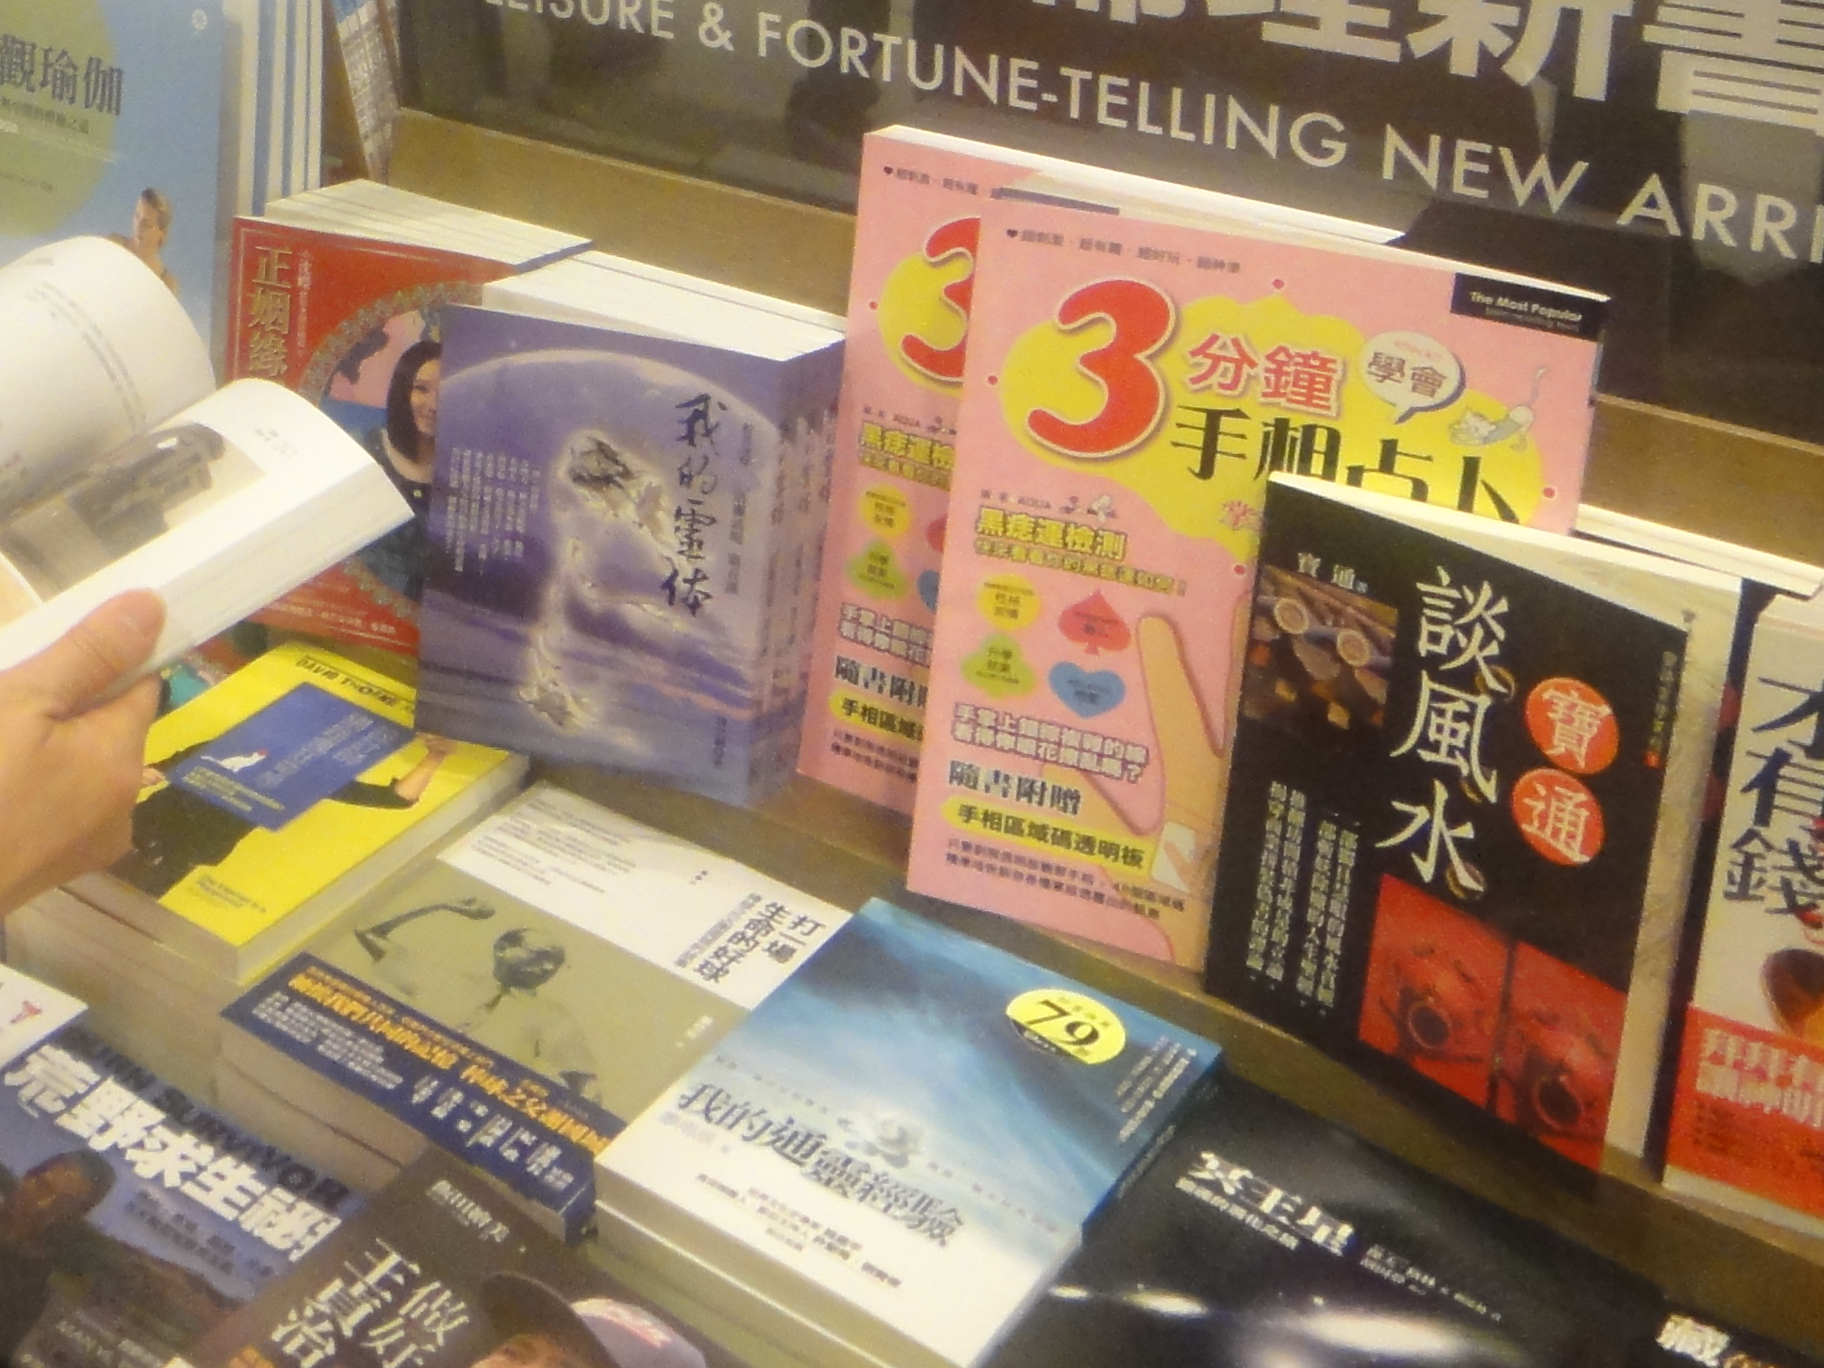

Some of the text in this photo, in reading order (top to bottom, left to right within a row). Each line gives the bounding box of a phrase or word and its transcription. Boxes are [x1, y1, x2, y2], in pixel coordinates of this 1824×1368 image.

[698, 2, 734, 51] &
[757, 13, 1348, 169] FORTUNE-TELLING
[1381, 124, 1589, 213] NEW
[248, 245, 293, 378] 正姻緣
[1470, 291, 1494, 305] The
[1495, 295, 1529, 312] Most
[1530, 303, 1583, 323] Popular
[1027, 279, 1175, 460] 3
[1188, 332, 1340, 417] 分鐘
[1366, 351, 1448, 399] 學會
[1376, 566, 1510, 893] 談風水
[693, 902, 792, 983] 生命的好球
[1027, 998, 1100, 1046] 79
[678, 1083, 964, 1248] 我的通靈經驗
